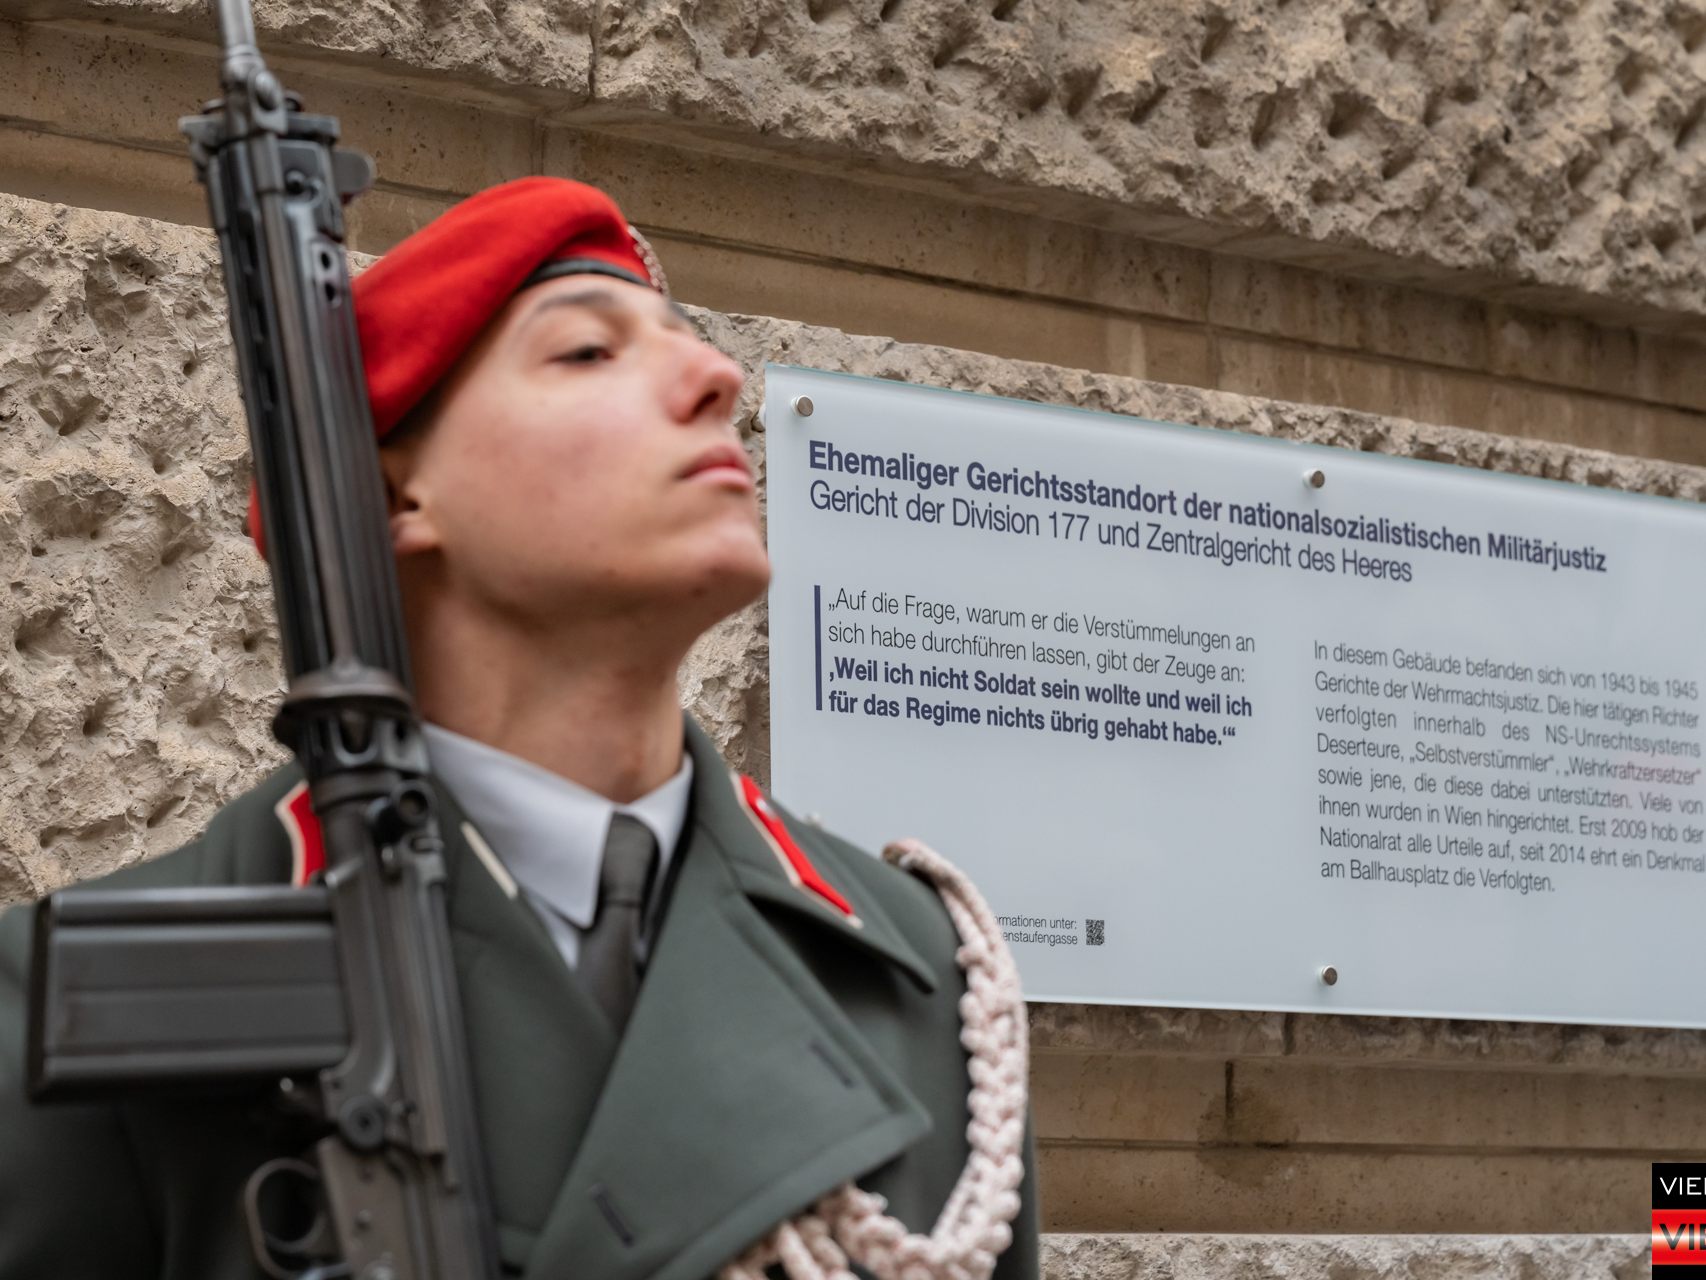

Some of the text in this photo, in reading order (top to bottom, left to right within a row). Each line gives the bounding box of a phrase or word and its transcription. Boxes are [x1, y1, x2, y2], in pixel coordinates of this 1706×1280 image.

[809, 440, 1607, 572] Ehemaliger Gerichtsstandort der nationalsozialistischen Militärjustiz
[810, 480, 1412, 582] Gericht der Division 177 und Zentralgericht des Heeres
[872, 592, 899, 614] die
[905, 595, 959, 625] Frage,
[966, 607, 1025, 628] warum
[1031, 614, 1048, 630] er
[1054, 611, 1079, 634] die
[1083, 614, 1230, 653] Verstümmelungen
[1236, 636, 1255, 652] an
[828, 621, 1244, 684] sich habe durchführen lassen, gibt der Zeuge an:
[1314, 640, 1698, 701] In diesem Gebäude befanden sich von 1943 bis 1945
[884, 661, 914, 685] ich
[920, 666, 969, 691] nicht
[974, 670, 1036, 697] Soldat
[1041, 678, 1080, 701] sein
[1084, 683, 1141, 707] wollte
[1146, 689, 1180, 710] und
[1185, 693, 1221, 714] weil
[1226, 694, 1252, 717] ich
[1315, 670, 1699, 729] Gerichte der Wehrmachtsjustiz. Die hier tätigen Richter
[828, 690, 858, 713] für
[863, 693, 900, 717] das
[906, 696, 981, 726] Regime
[987, 705, 1045, 730] nichts
[1050, 710, 1098, 740] übrig
[1104, 717, 1168, 741] gehabt
[1315, 704, 1701, 758] verfolgten innerhalb des NS-Unrechtssystems
[1317, 732, 1404, 763] Deserteure,
[1318, 766, 1704, 815] sowie jene, die diese dabei unterstützten. Viele von
[1318, 794, 1704, 844] ihnen wurden in Wien hingerichtet. Erst 2009 hob der
[1320, 825, 1706, 873] Nationalrat alle Urteile auf, seit 2014 ehrt ein Denkmal
[1321, 858, 1555, 895] am Ballhausplatz die Verfolgten.
[1003, 930, 1078, 947] enstaufengasse
[1050, 917, 1077, 930] unter:
